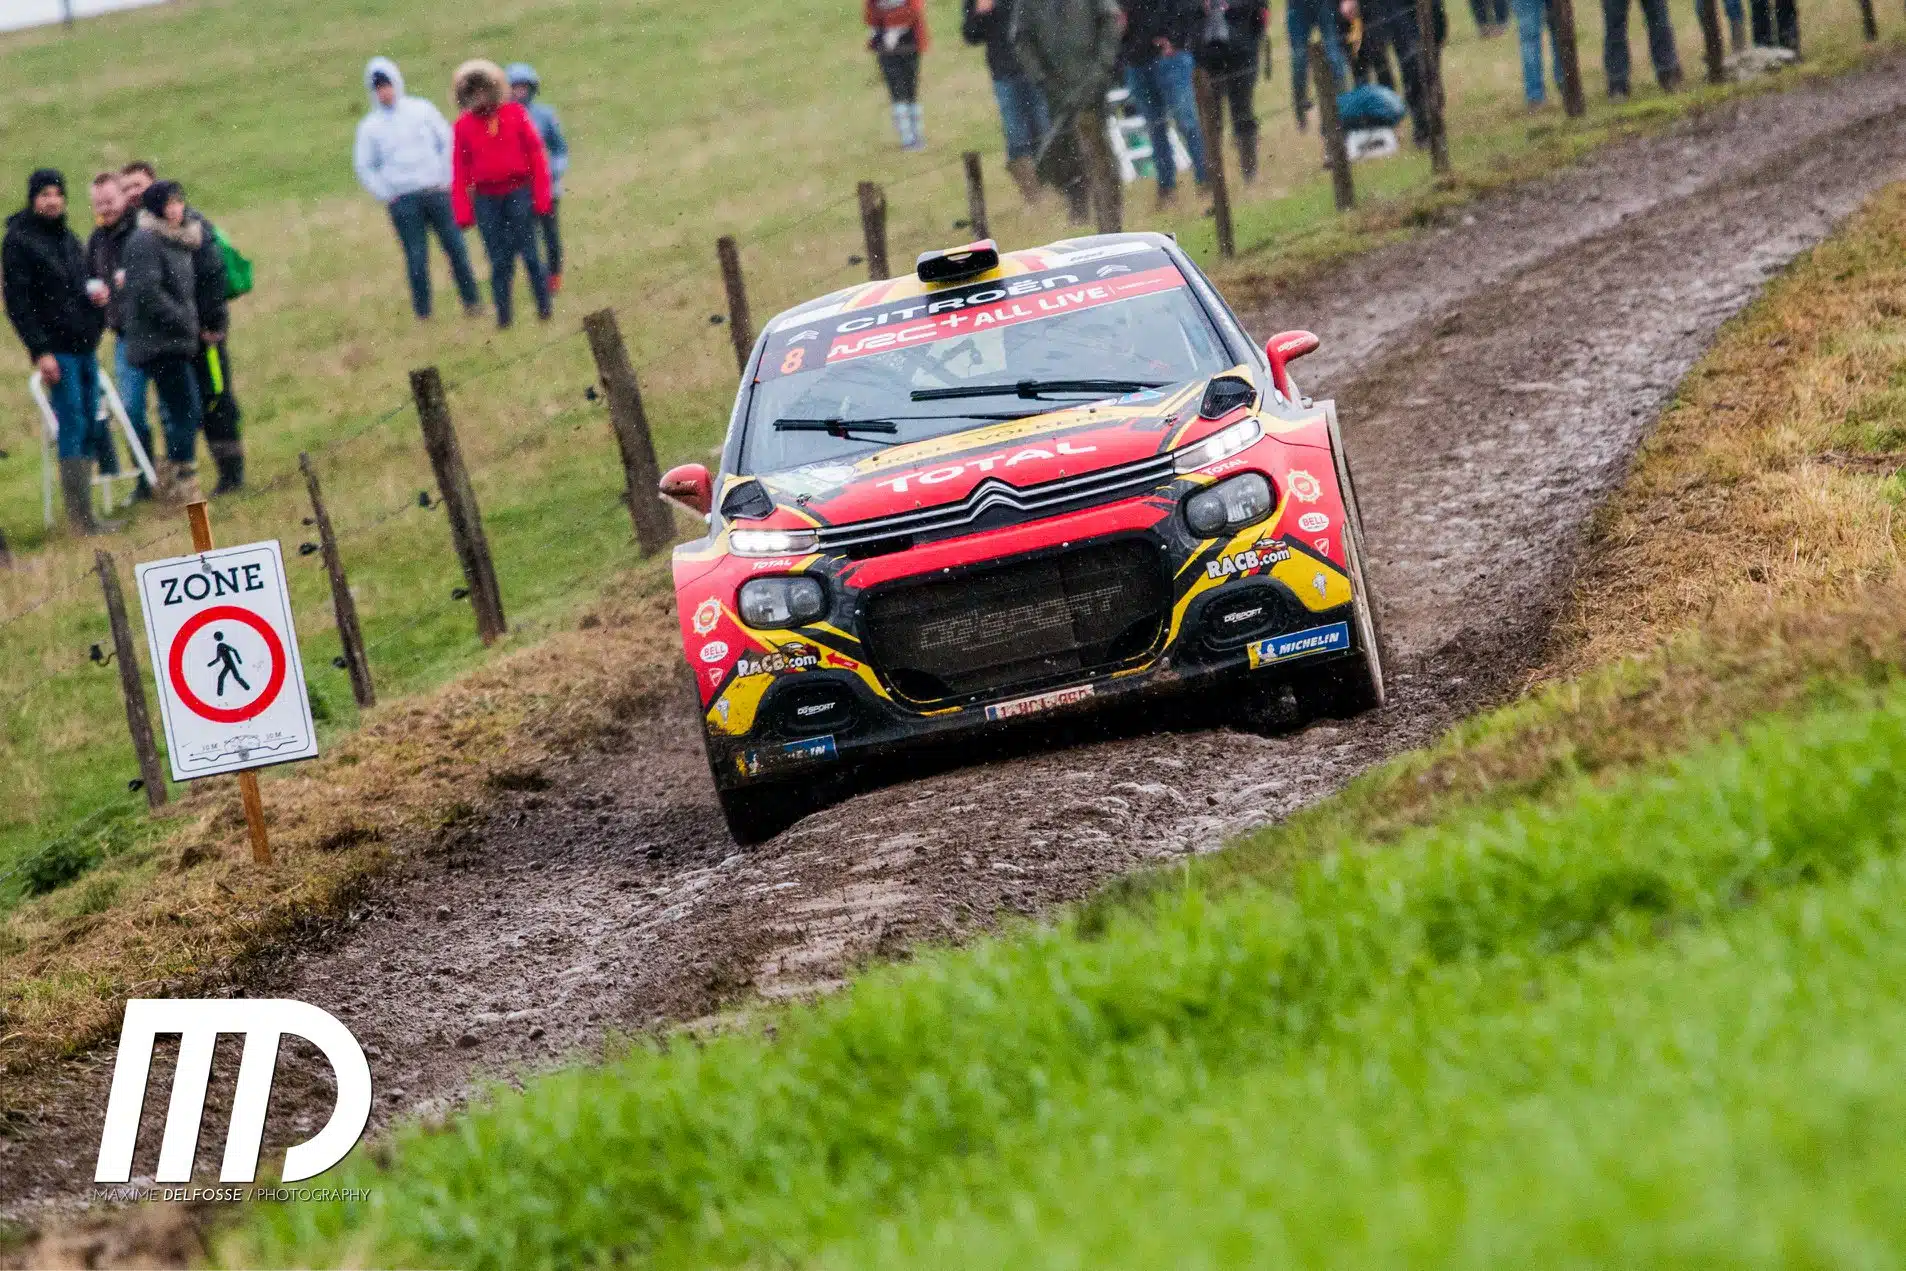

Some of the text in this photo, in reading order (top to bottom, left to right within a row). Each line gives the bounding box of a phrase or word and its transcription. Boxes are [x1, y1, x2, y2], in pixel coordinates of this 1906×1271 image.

[973, 304, 1032, 327] ALL
[1039, 286, 1108, 311] LIVE
[781, 347, 805, 374] 8
[875, 442, 1097, 493] TOTAL
[1201, 458, 1249, 477] TOTAL
[1302, 515, 1327, 527] BELL
[751, 559, 793, 571] TOTAL
[1205, 549, 1291, 579] RACB.com
[160, 563, 265, 606] ZONE
[703, 643, 726, 656] BELL
[1279, 631, 1340, 655] MICHELIN
